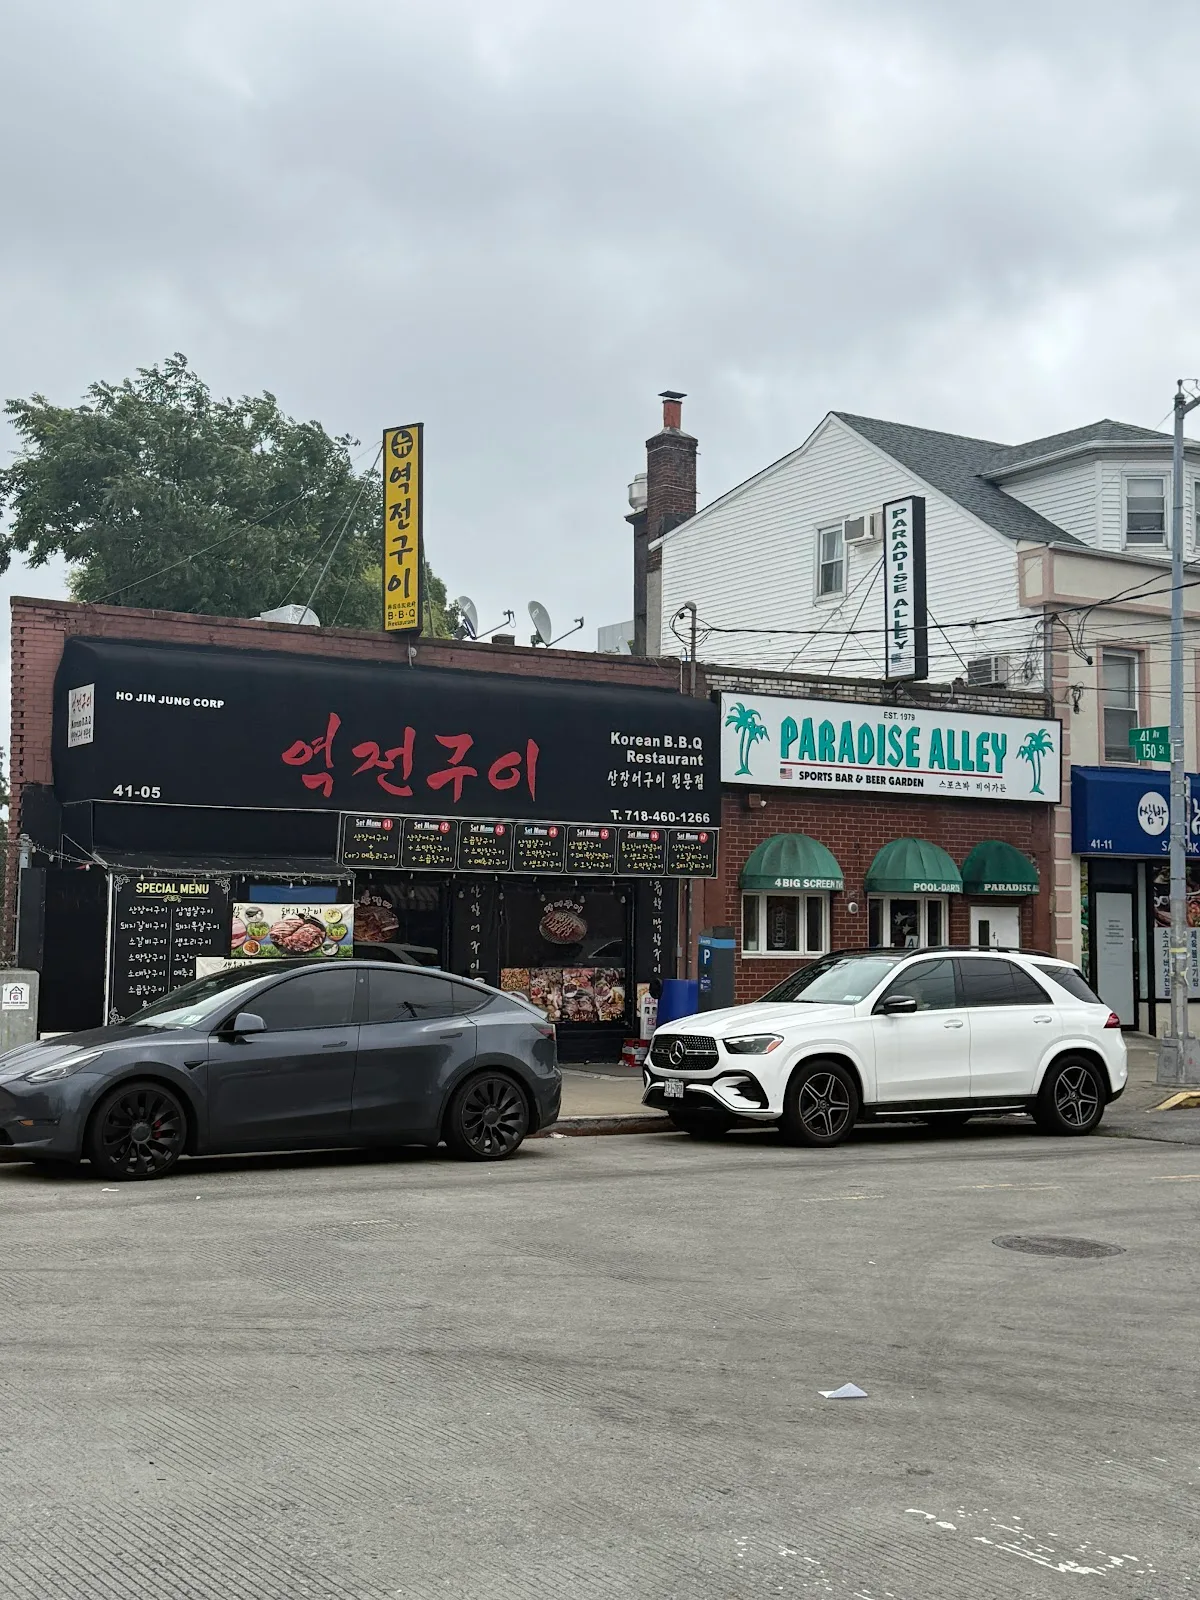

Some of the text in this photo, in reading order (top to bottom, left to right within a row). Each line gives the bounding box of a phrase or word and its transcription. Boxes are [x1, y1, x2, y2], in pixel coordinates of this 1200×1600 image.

[393, 432, 412, 455] 뉴
[388, 462, 413, 598] 역전구이
[892, 508, 909, 649] PARADISE ALLEY
[116, 691, 225, 708] HO JIN JUNG CORP
[884, 712, 916, 721] EST. 1979
[610, 732, 702, 750] Korean B.B.Q
[1140, 730, 1150, 742] 41
[780, 716, 1007, 774] PARADISE ALLEY
[1142, 743, 1164, 758] 150 St
[626, 750, 703, 766] Restaurant
[608, 770, 704, 790] 산장어구이 전문점
[799, 771, 924, 788] SPORTS BAR & BEER GARDEN
[113, 784, 161, 799] 41-05
[610, 810, 710, 823] T. 718-460-1266
[1090, 839, 1112, 850] 41-11
[136, 882, 209, 894] SPECIAL MENU
[803, 879, 834, 888] SCREEN
[984, 884, 1032, 892] PARADISE
[128, 906, 168, 914] 산장어구이
[176, 907, 214, 917] 삼겹살구이
[120, 920, 168, 932] 돼지갈비구이
[129, 936, 166, 948] 소갈비구이
[174, 938, 212, 947] 생오리구이
[128, 953, 166, 963] 소막창구이
[704, 948, 710, 964] P
[128, 970, 166, 978] 소대창구이
[128, 984, 165, 995] 소곱창구이
